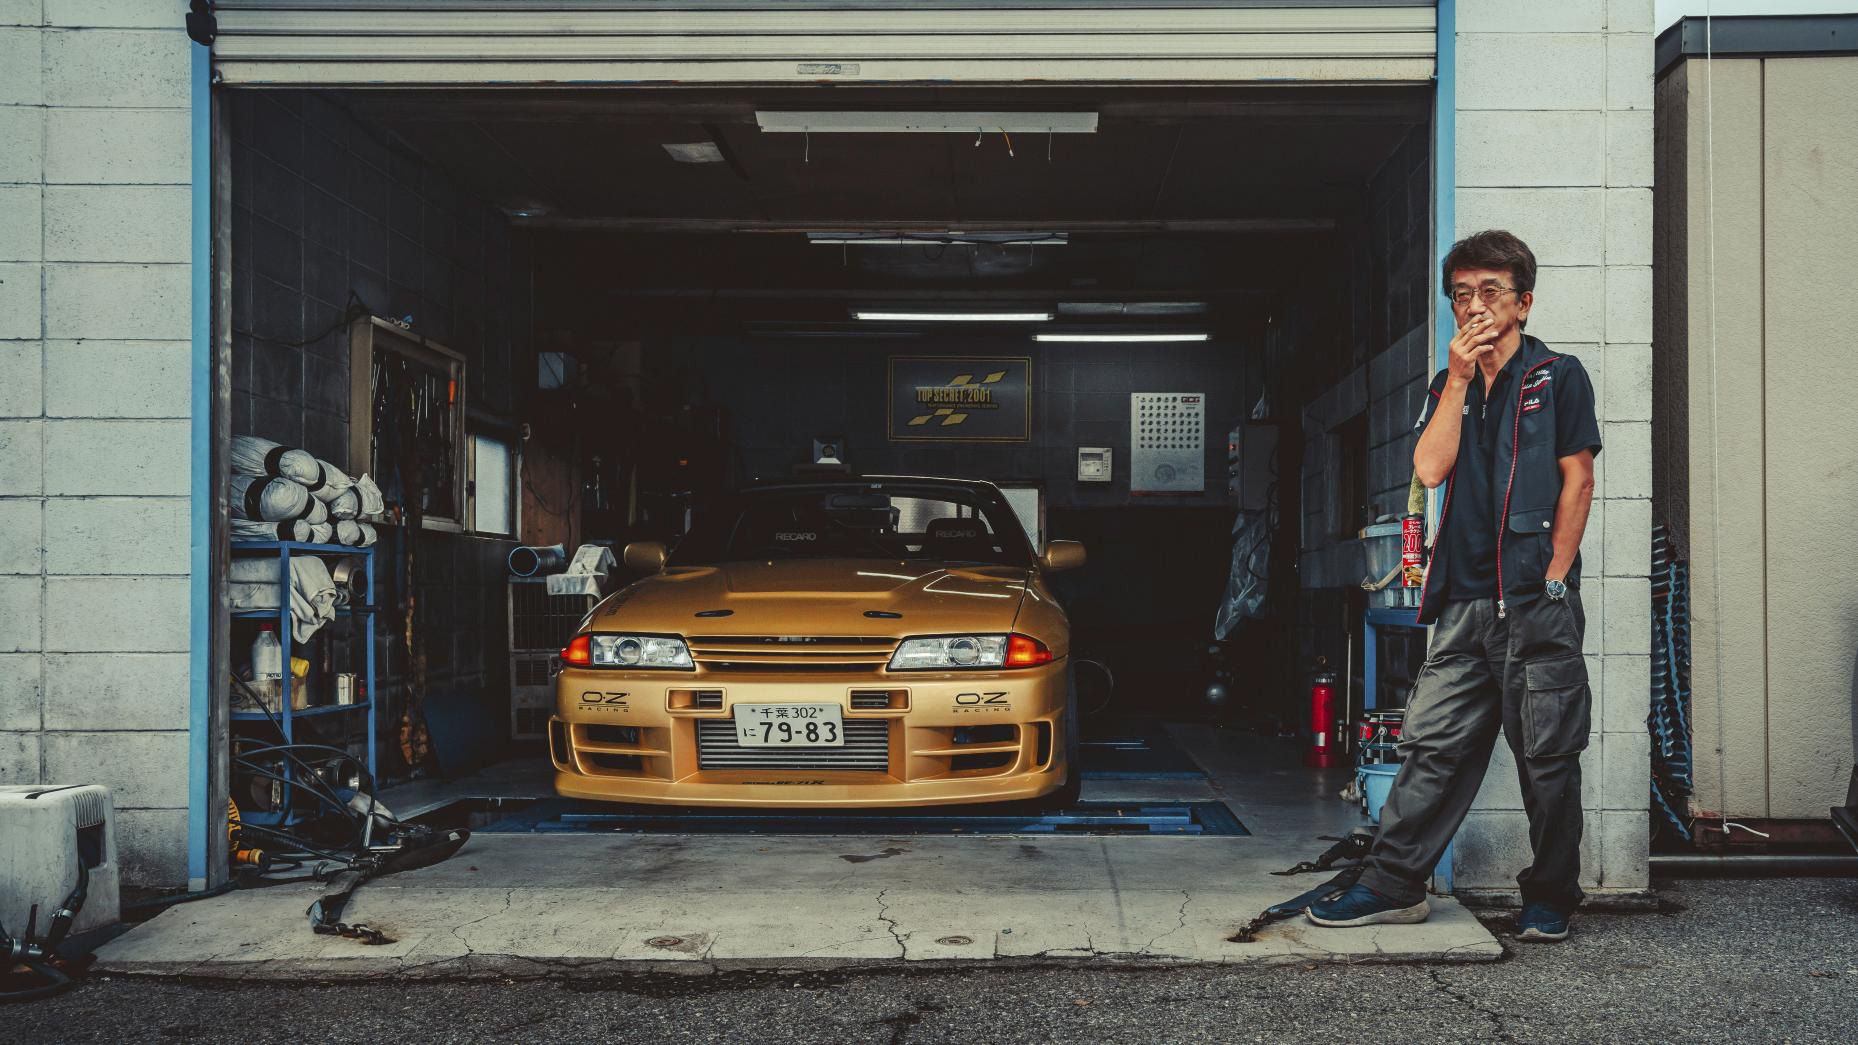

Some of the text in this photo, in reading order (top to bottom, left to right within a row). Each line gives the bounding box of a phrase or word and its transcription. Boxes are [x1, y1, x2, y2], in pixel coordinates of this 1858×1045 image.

[917, 388, 933, 402] TOP
[775, 532, 817, 541] RECARO
[935, 529, 977, 538] RECARO
[743, 722, 837, 743] に 79-83
